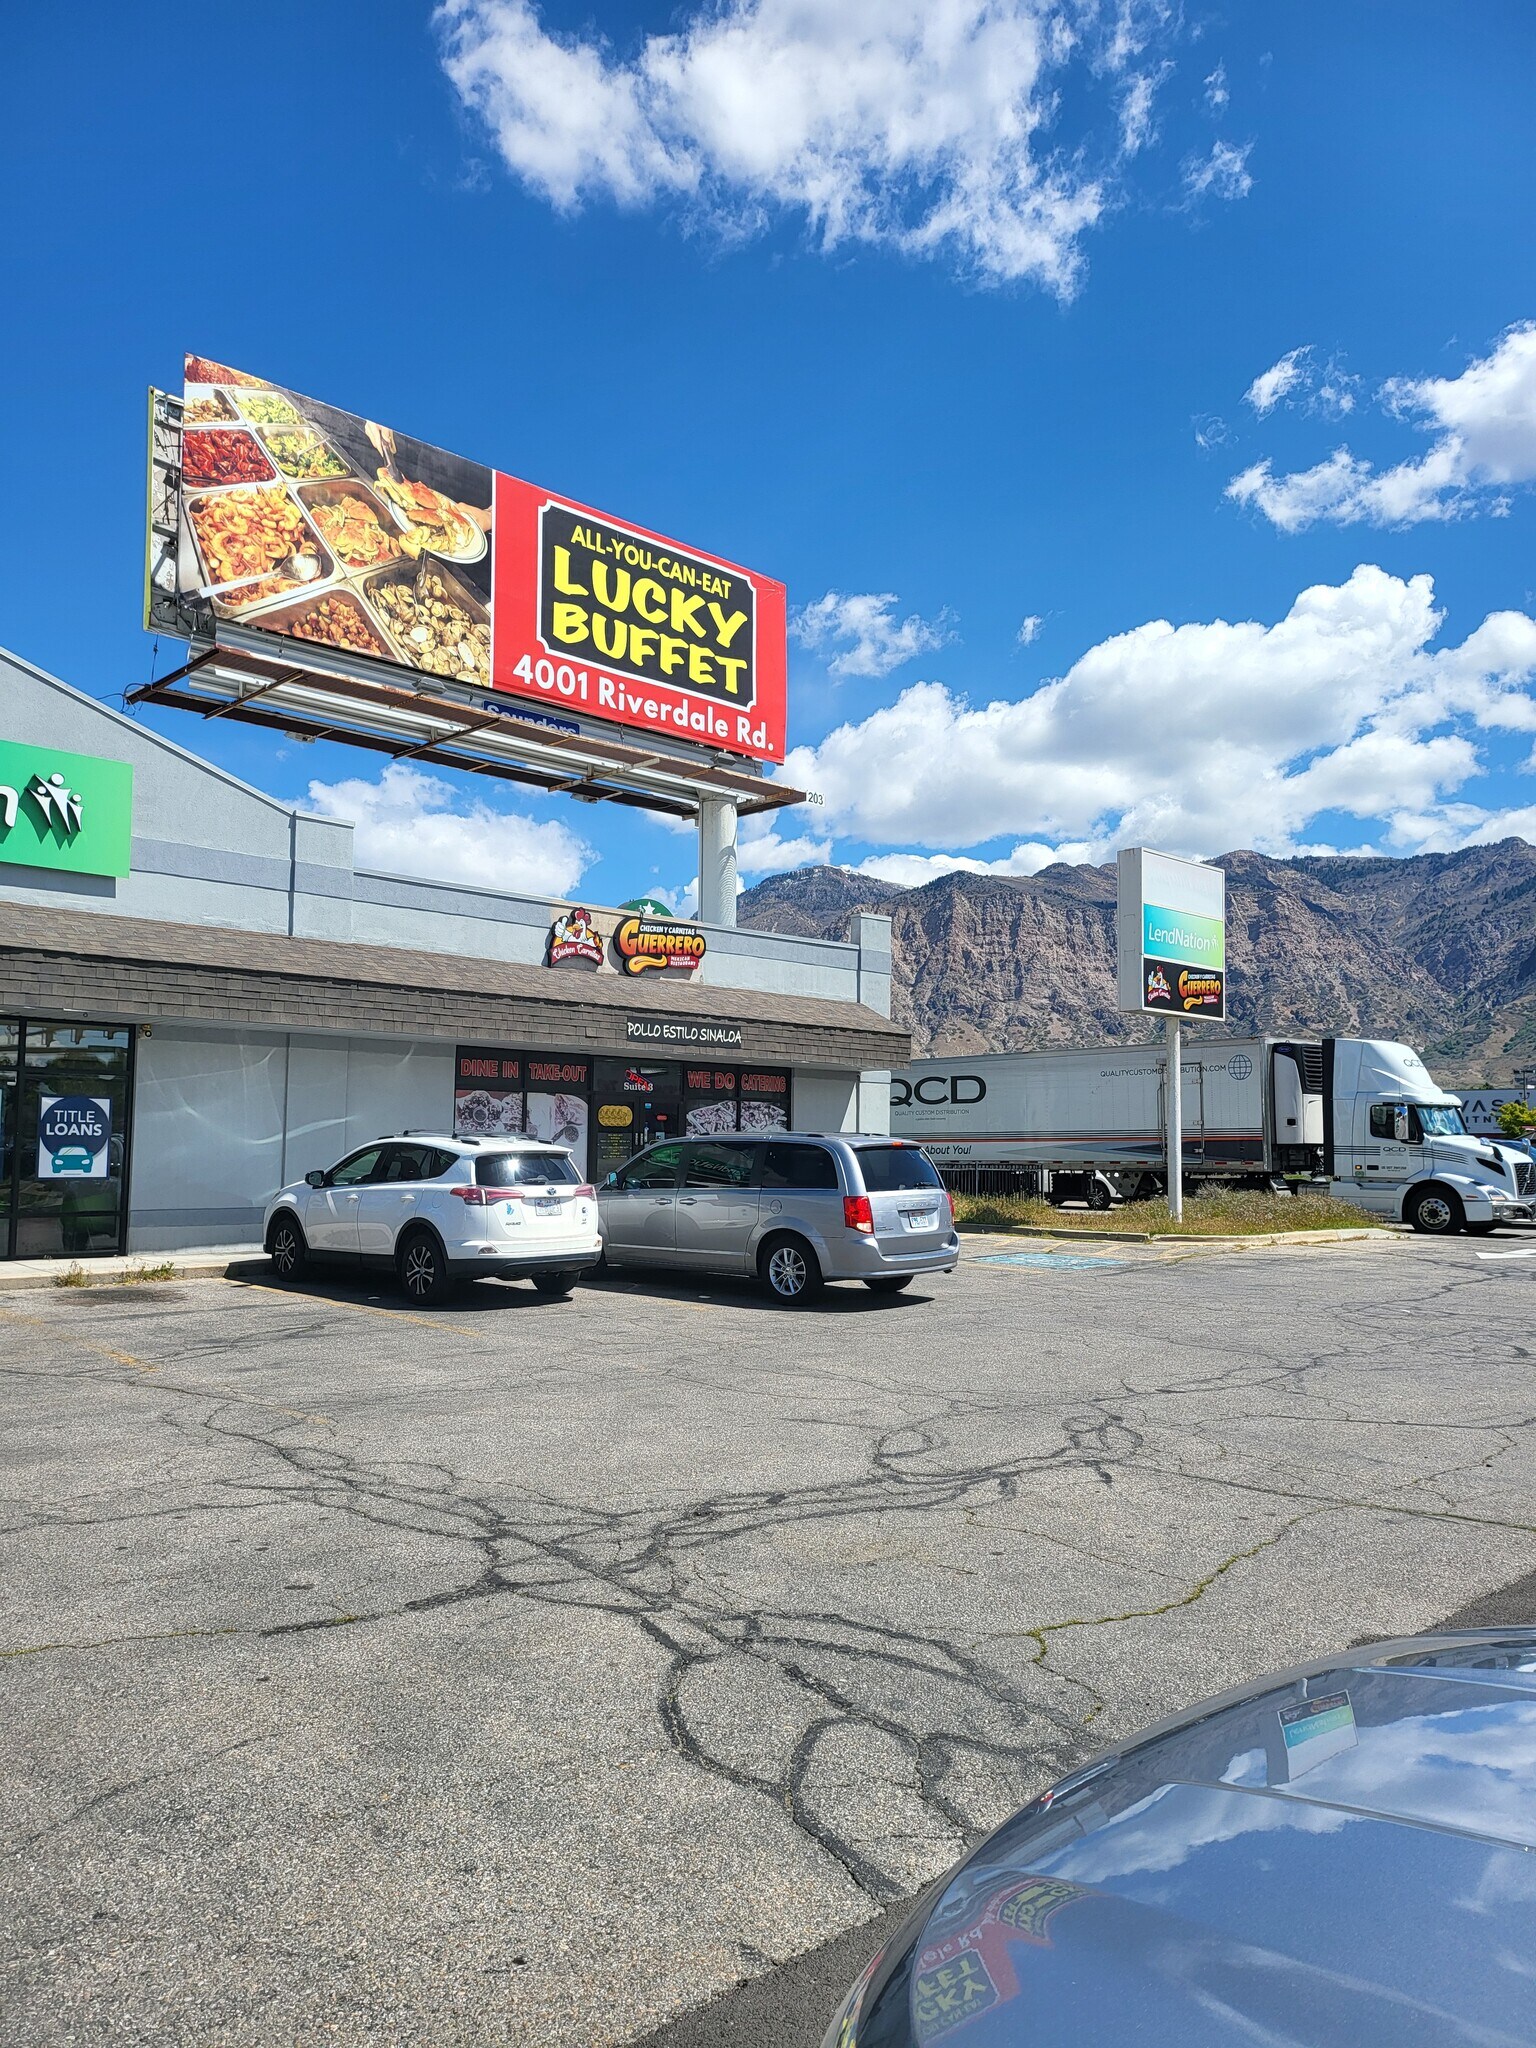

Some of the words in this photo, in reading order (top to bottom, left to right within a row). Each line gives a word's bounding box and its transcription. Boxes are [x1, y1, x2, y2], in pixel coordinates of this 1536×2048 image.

[570, 524, 732, 600] ALL-YOU-CAN-EAT
[553, 545, 748, 648] LUCKY
[552, 601, 748, 695] BUFFET
[512, 654, 588, 700] 4001
[598, 676, 729, 738] Riverdale
[736, 715, 774, 751] Rd.
[808, 791, 824, 805] 203
[619, 918, 705, 957] GUERRERO
[639, 924, 663, 933] CHICKEN
[664, 926, 669, 934] Y
[668, 926, 695, 936] CARNITAS
[1148, 922, 1210, 951] LendNation
[552, 945, 576, 959] Chicken
[1178, 970, 1221, 998] GUERRERO
[627, 1022, 661, 1038] POLLO
[663, 1025, 699, 1040] ESTILO
[699, 1028, 742, 1044] SINALOA
[460, 1058, 498, 1078] DINE
[502, 1061, 519, 1079] IN
[528, 1062, 587, 1083] TAKE-OUT
[687, 1070, 711, 1089] WE
[714, 1072, 735, 1090] DO
[740, 1073, 787, 1093] CATERING
[623, 1081, 646, 1091] Suite
[890, 1075, 987, 1107] QCD
[54, 1110, 96, 1123] TITLE
[46, 1123, 103, 1136] LOANS
[952, 1145, 972, 1155] You!
